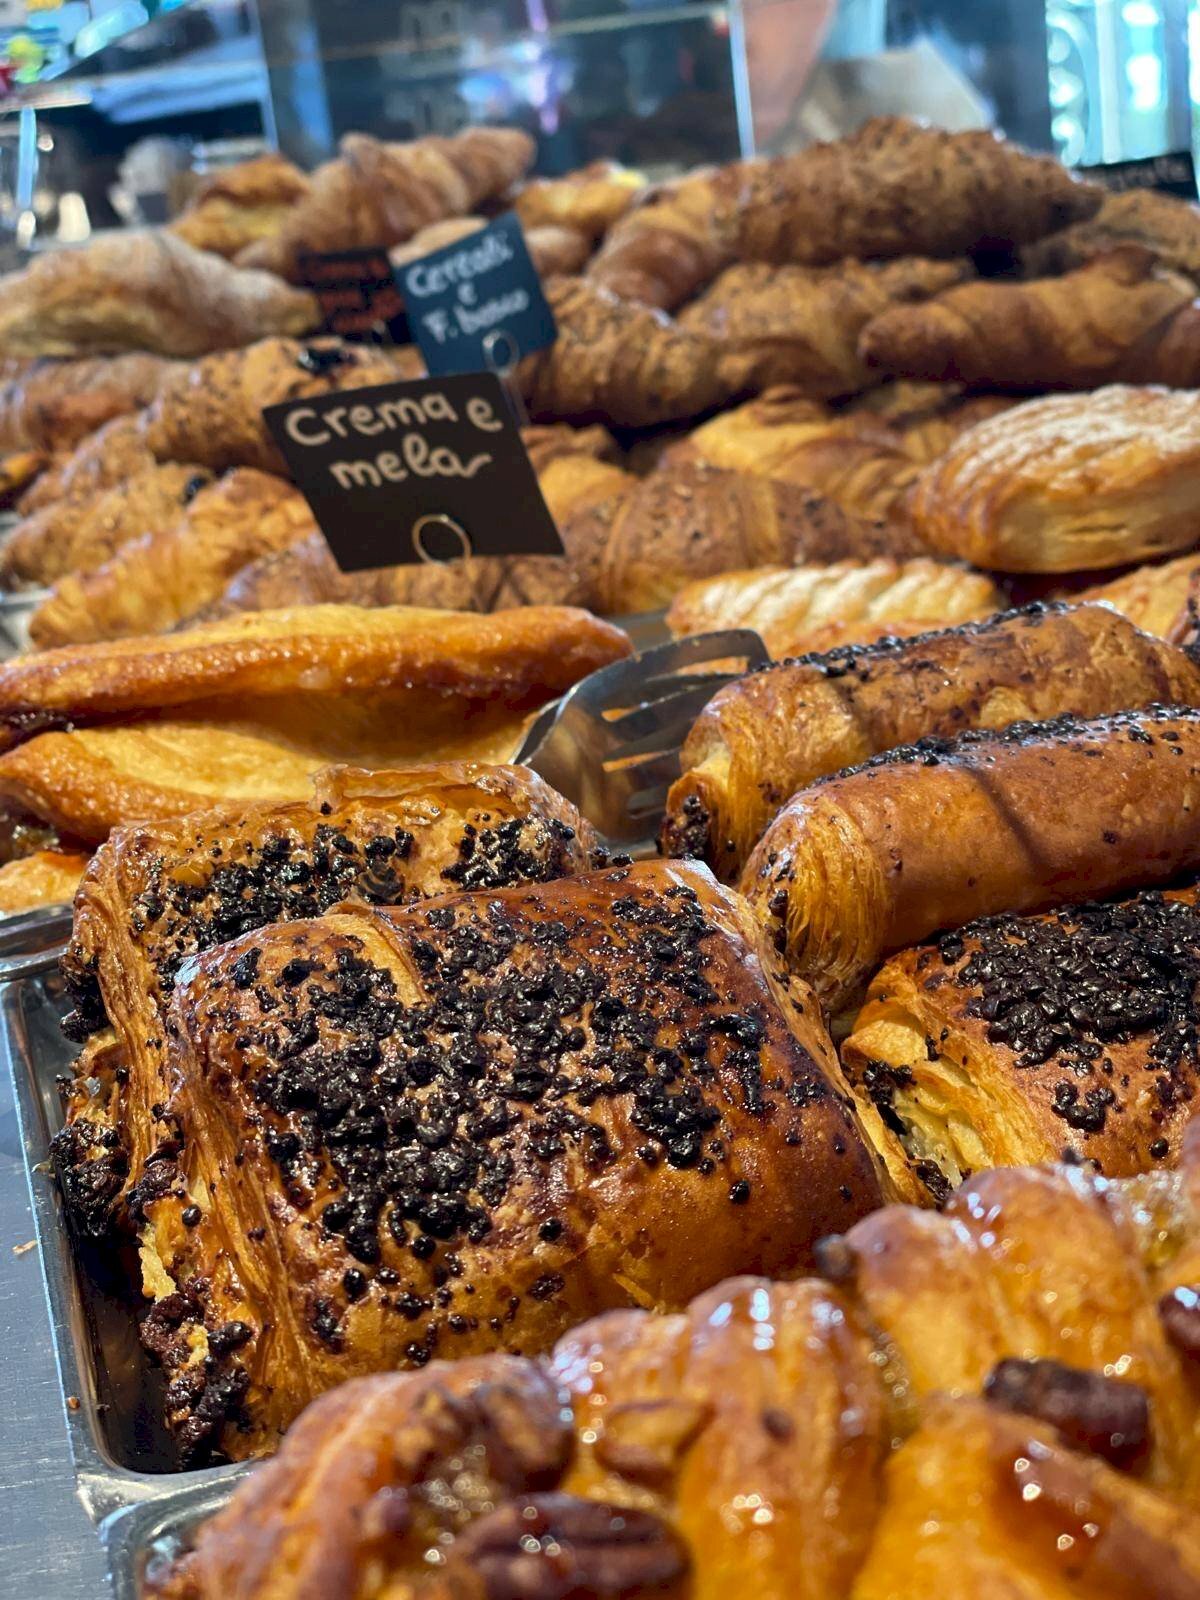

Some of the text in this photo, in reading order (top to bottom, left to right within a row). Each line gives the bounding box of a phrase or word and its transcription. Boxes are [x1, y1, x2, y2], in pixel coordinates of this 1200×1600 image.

[286, 393, 503, 446] Crema e
[330, 434, 493, 489] mela
